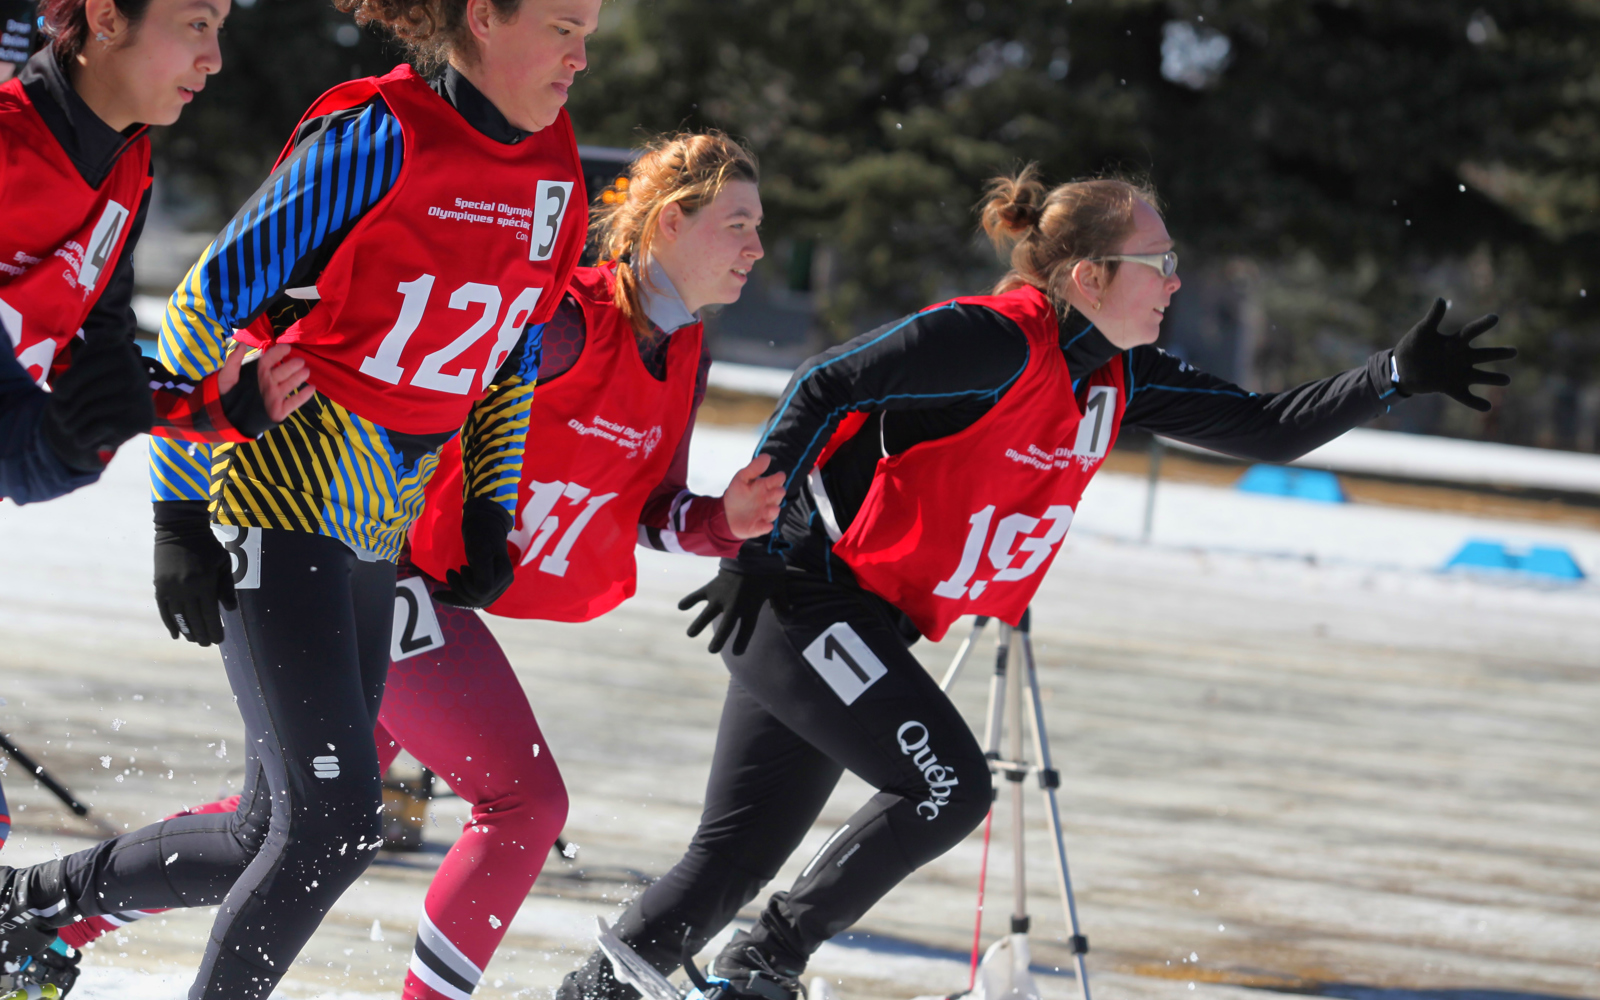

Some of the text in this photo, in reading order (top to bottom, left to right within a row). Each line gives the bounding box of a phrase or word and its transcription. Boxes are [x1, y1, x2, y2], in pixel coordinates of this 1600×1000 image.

[427, 206, 494, 224] Olympiques
[454, 197, 496, 212] Special
[537, 185, 566, 258] 3
[90, 210, 122, 286] 4
[1086, 390, 1109, 453] 1
[224, 526, 249, 586] 3
[395, 585, 434, 655] 2
[823, 632, 872, 686] 1
